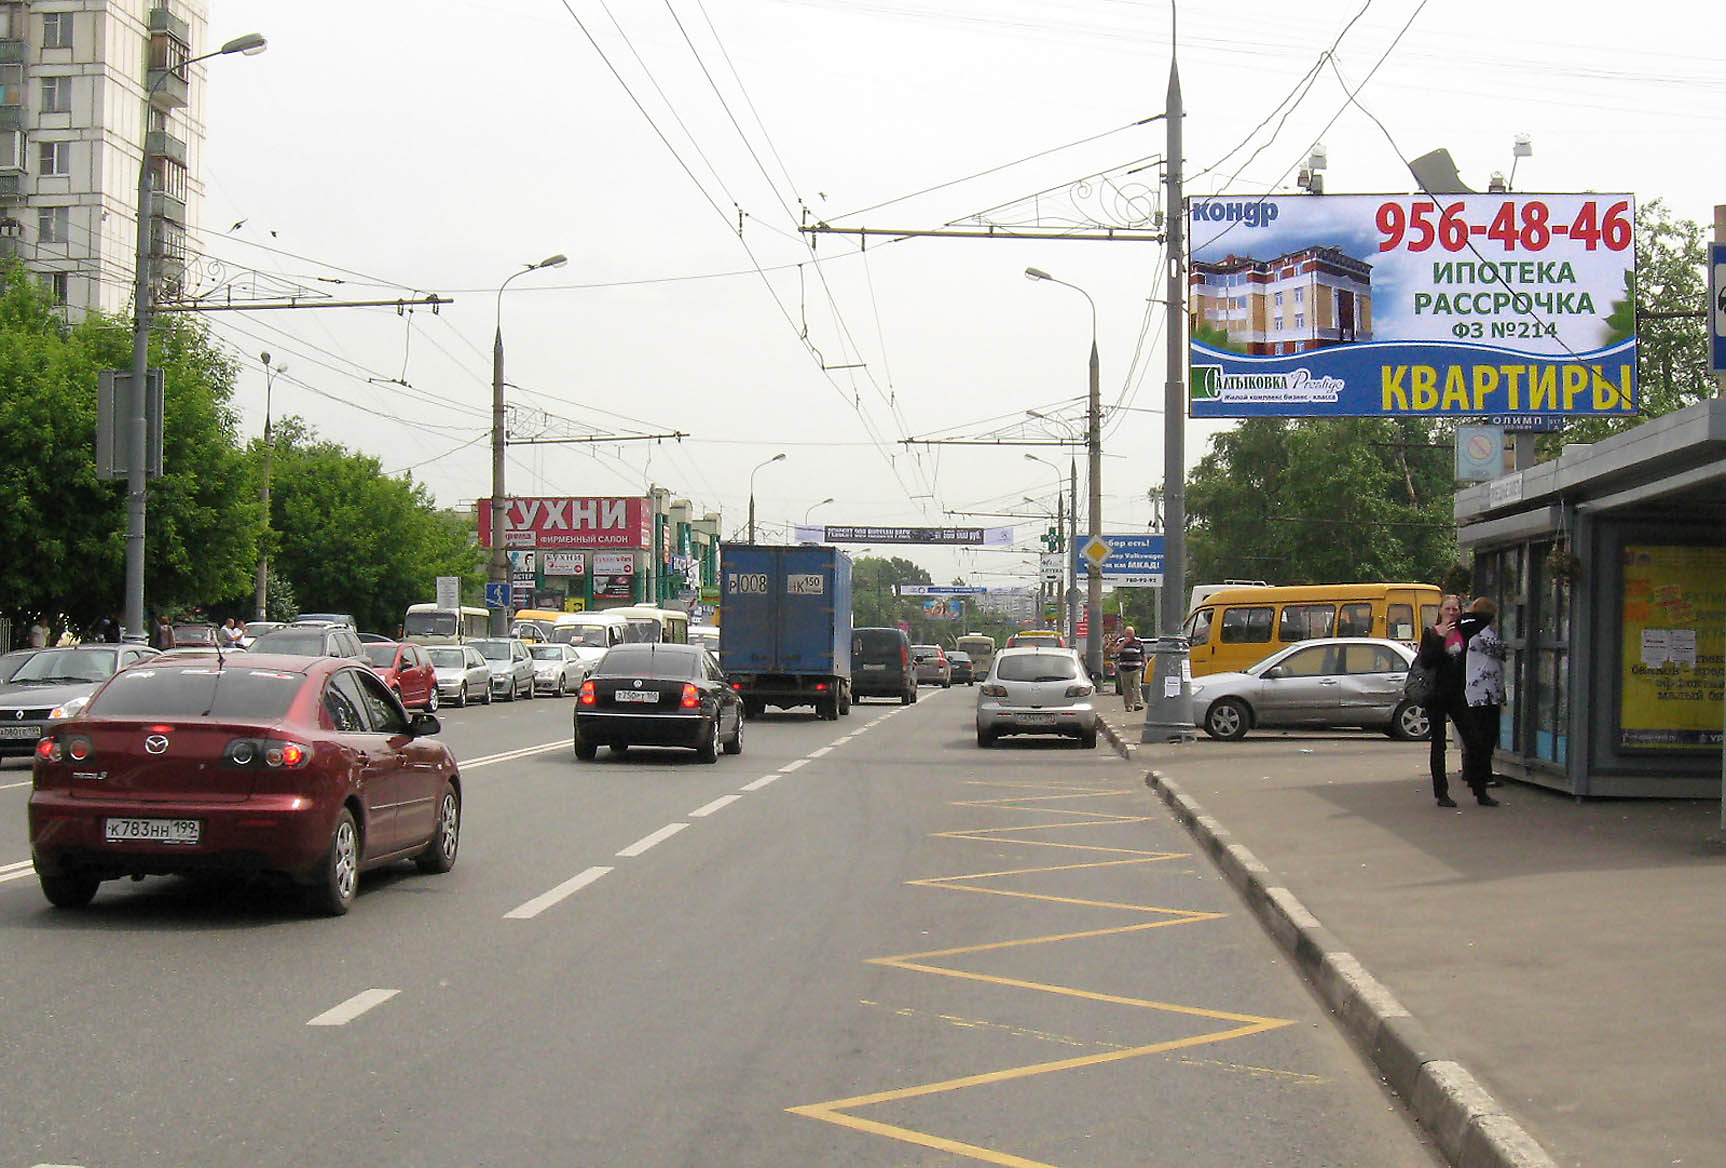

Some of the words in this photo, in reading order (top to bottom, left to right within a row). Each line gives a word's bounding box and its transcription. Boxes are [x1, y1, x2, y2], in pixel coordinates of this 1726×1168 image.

[1376, 201, 1632, 252] 956-48-46
[1433, 262, 1576, 284] ИПОТЕКА
[1414, 292, 1595, 316] РАССРОЧКА
[1452, 322, 1484, 338] ФЗ
[1491, 322, 1557, 338] №214
[1381, 364, 1632, 411] КВАРТИРЫ
[1492, 416, 1542, 425] ОЛИМП
[540, 534, 597, 544] ФИРМЕННЫЙ
[598, 535, 629, 544] САЛОН
